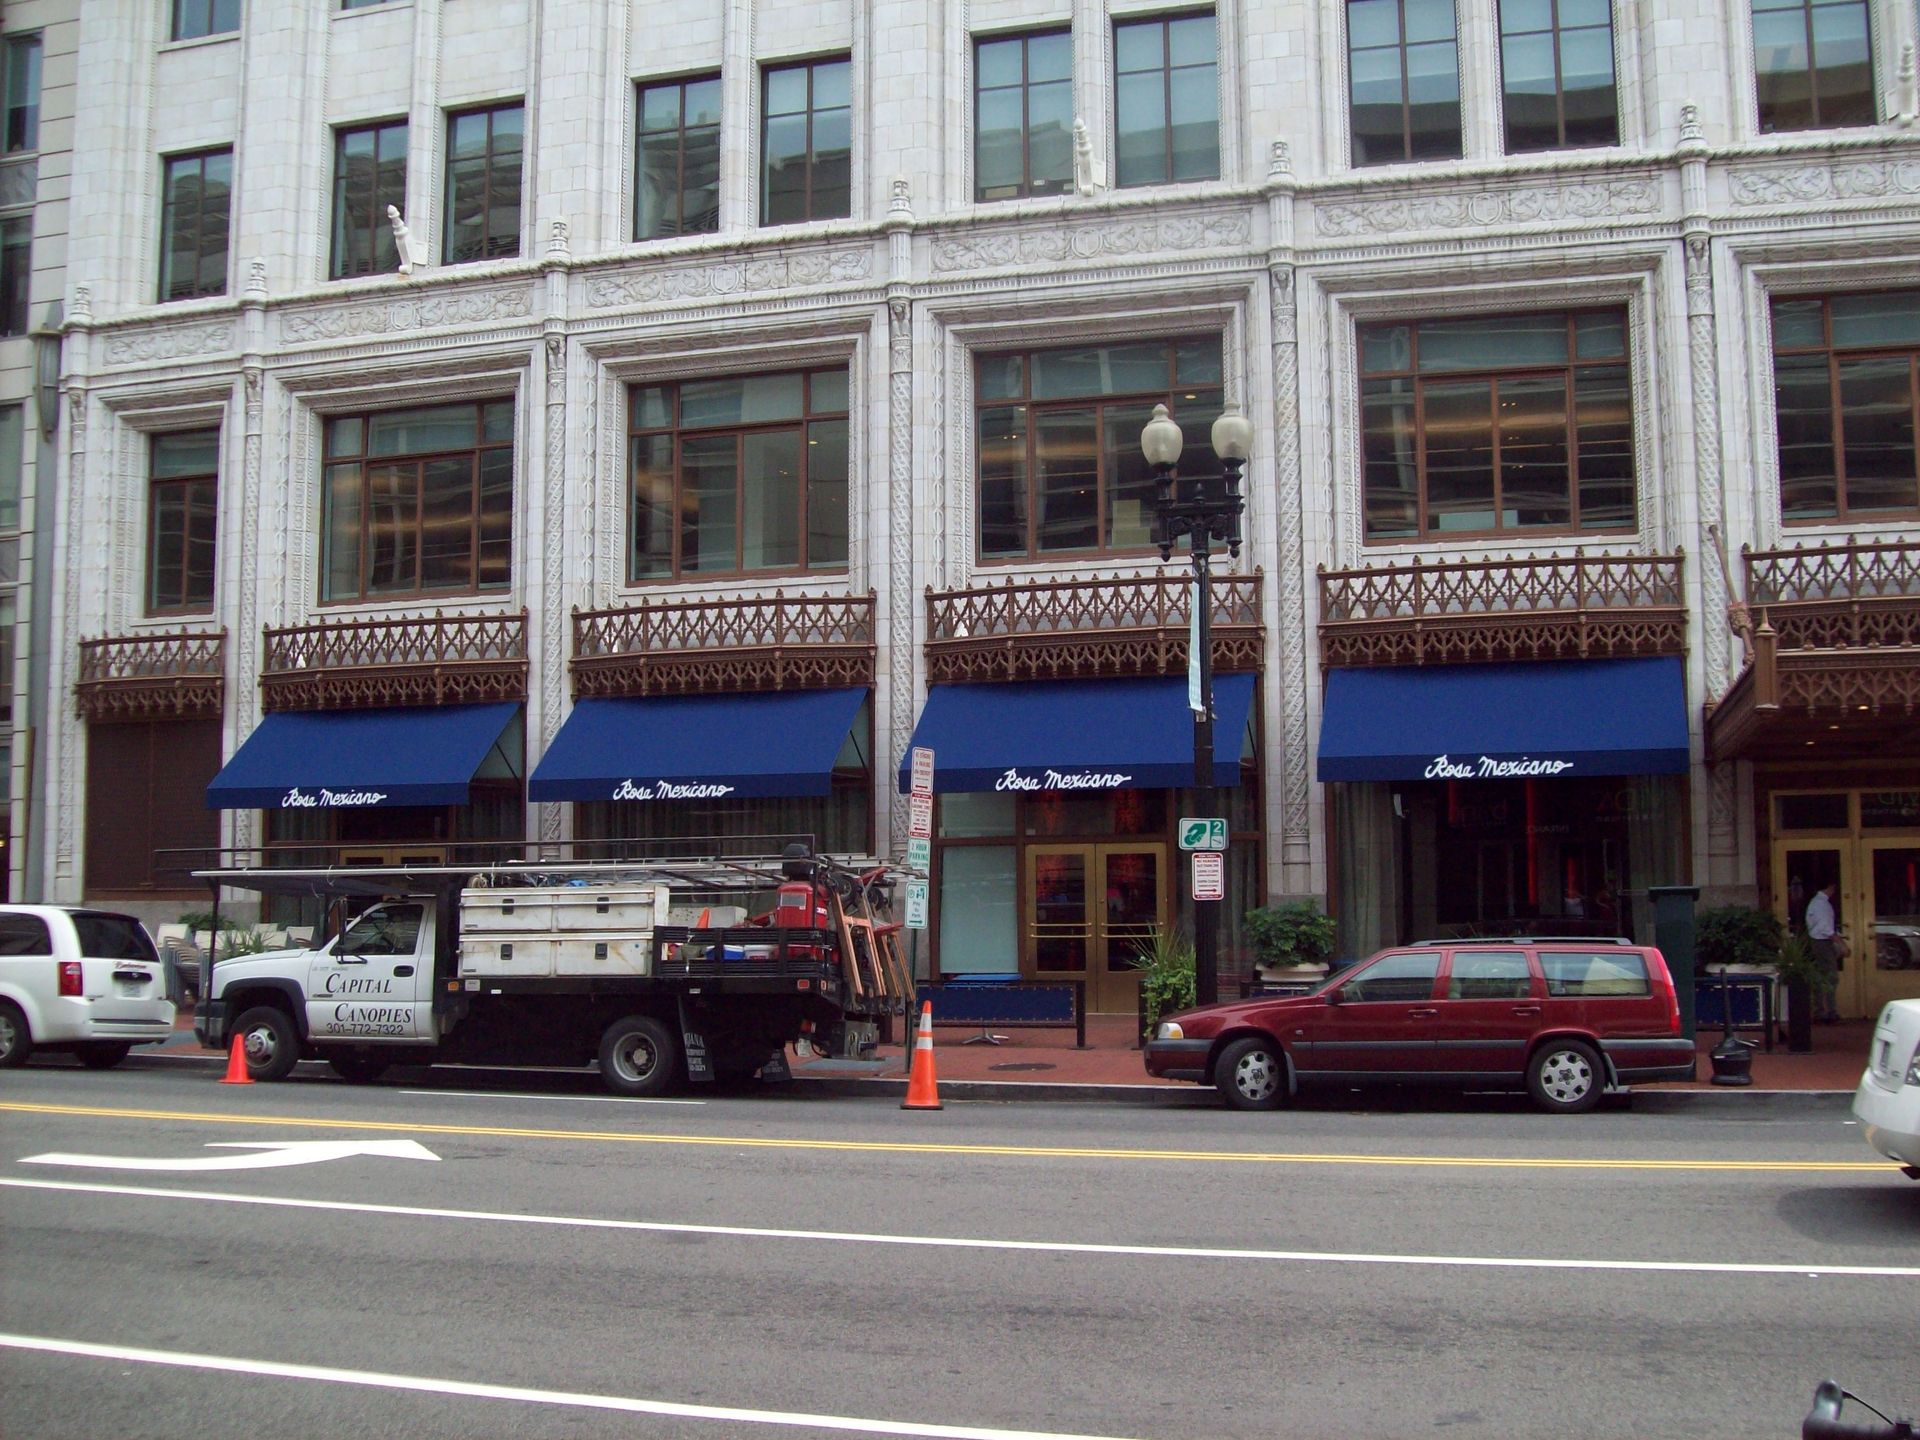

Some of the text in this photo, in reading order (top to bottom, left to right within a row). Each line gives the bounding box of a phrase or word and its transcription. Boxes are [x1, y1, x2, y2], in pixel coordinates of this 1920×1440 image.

[1424, 753, 1575, 779] Rosa Mexicano
[612, 778, 735, 801] Rosa Mexicano
[994, 767, 1133, 792] Rosa Mexicano
[281, 786, 388, 808] Rosa Mexicano
[1213, 821, 1222, 833] 2
[909, 852, 929, 861] PARKING
[326, 973, 392, 994] CAPITAL
[334, 1003, 412, 1024] CANOPIES
[326, 1022, 404, 1035] 301-772-7322
